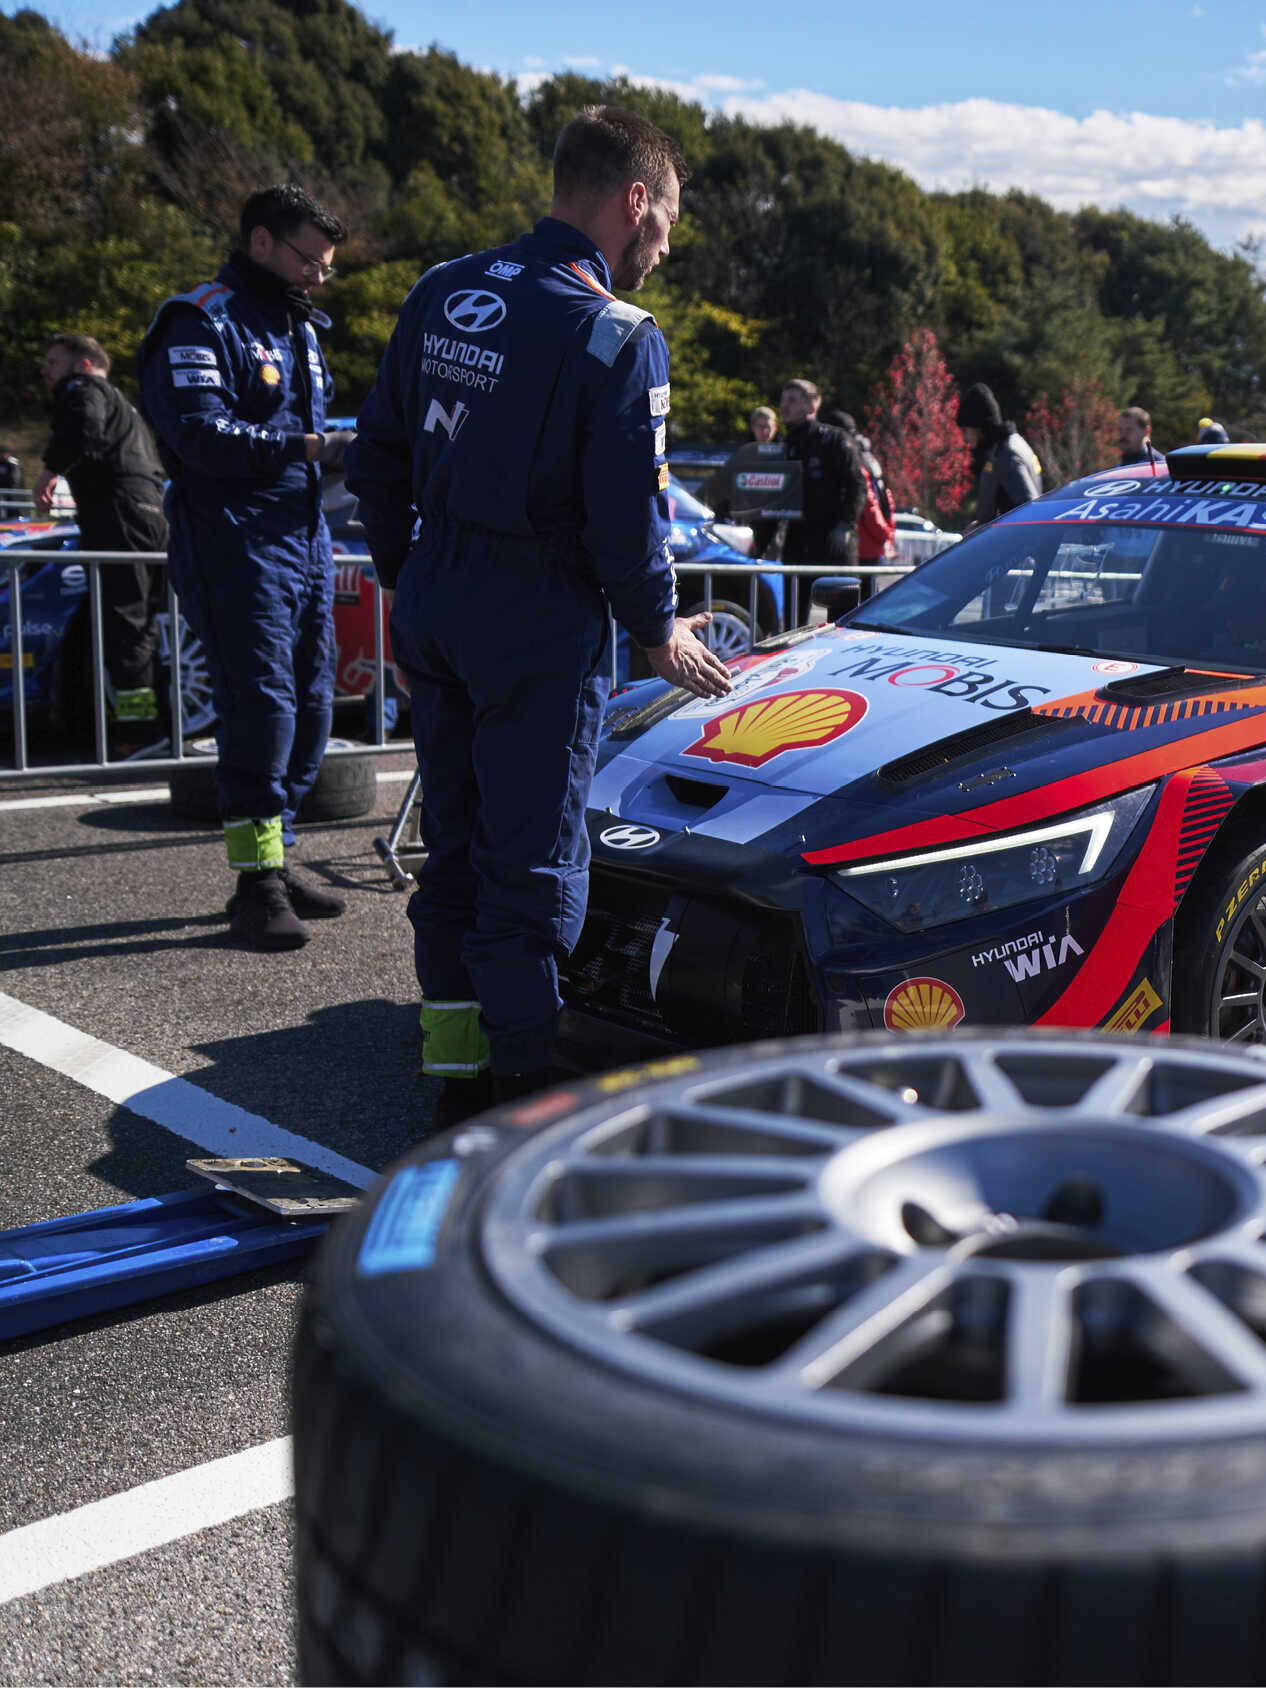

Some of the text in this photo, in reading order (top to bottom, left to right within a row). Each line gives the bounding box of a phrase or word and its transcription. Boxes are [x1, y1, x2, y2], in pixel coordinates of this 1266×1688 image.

[488, 262, 522, 278] OMP
[423, 332, 505, 375] HYUNDAI
[840, 644, 999, 669] HYUNDAI
[828, 657, 1052, 711] MOBIS
[971, 930, 1045, 968] HYUNDAI
[1003, 935, 1085, 983] WIA
